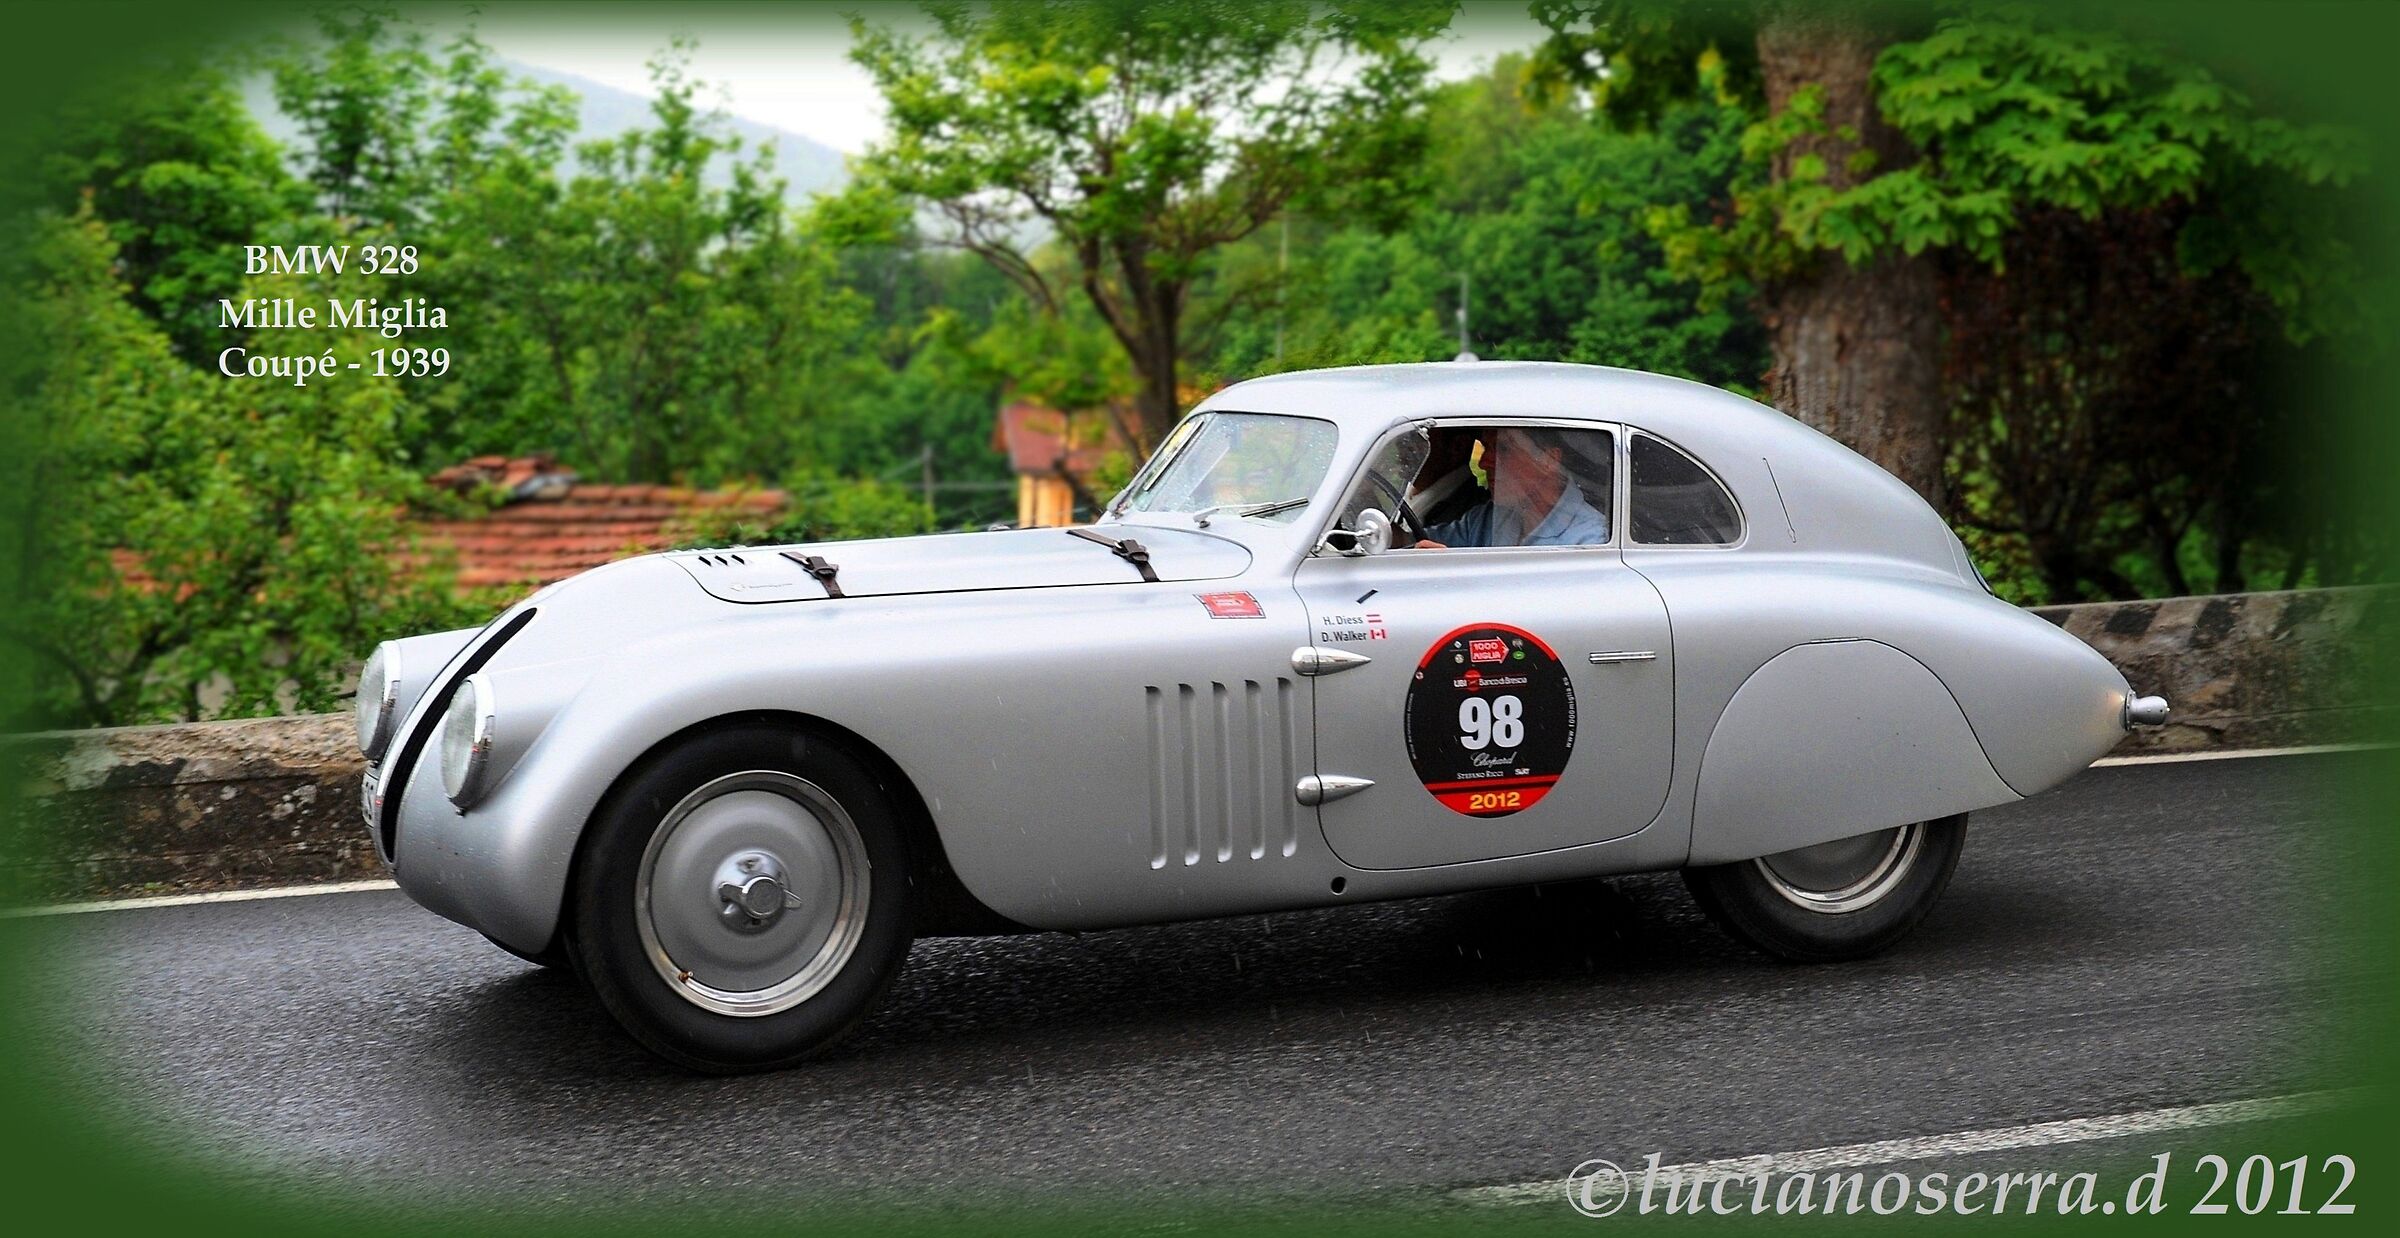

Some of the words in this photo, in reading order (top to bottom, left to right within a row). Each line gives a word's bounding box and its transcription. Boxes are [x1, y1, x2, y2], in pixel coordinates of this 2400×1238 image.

[1322, 616, 1335, 626] H.
[1335, 615, 1364, 625] Diess
[1321, 631, 1333, 642] D.
[1333, 630, 1367, 642] Walker
[1473, 642, 1499, 651] 1000
[1473, 651, 1501, 660] MIGLIA
[1458, 694, 1525, 750] 98
[1469, 791, 1521, 810] 2012
